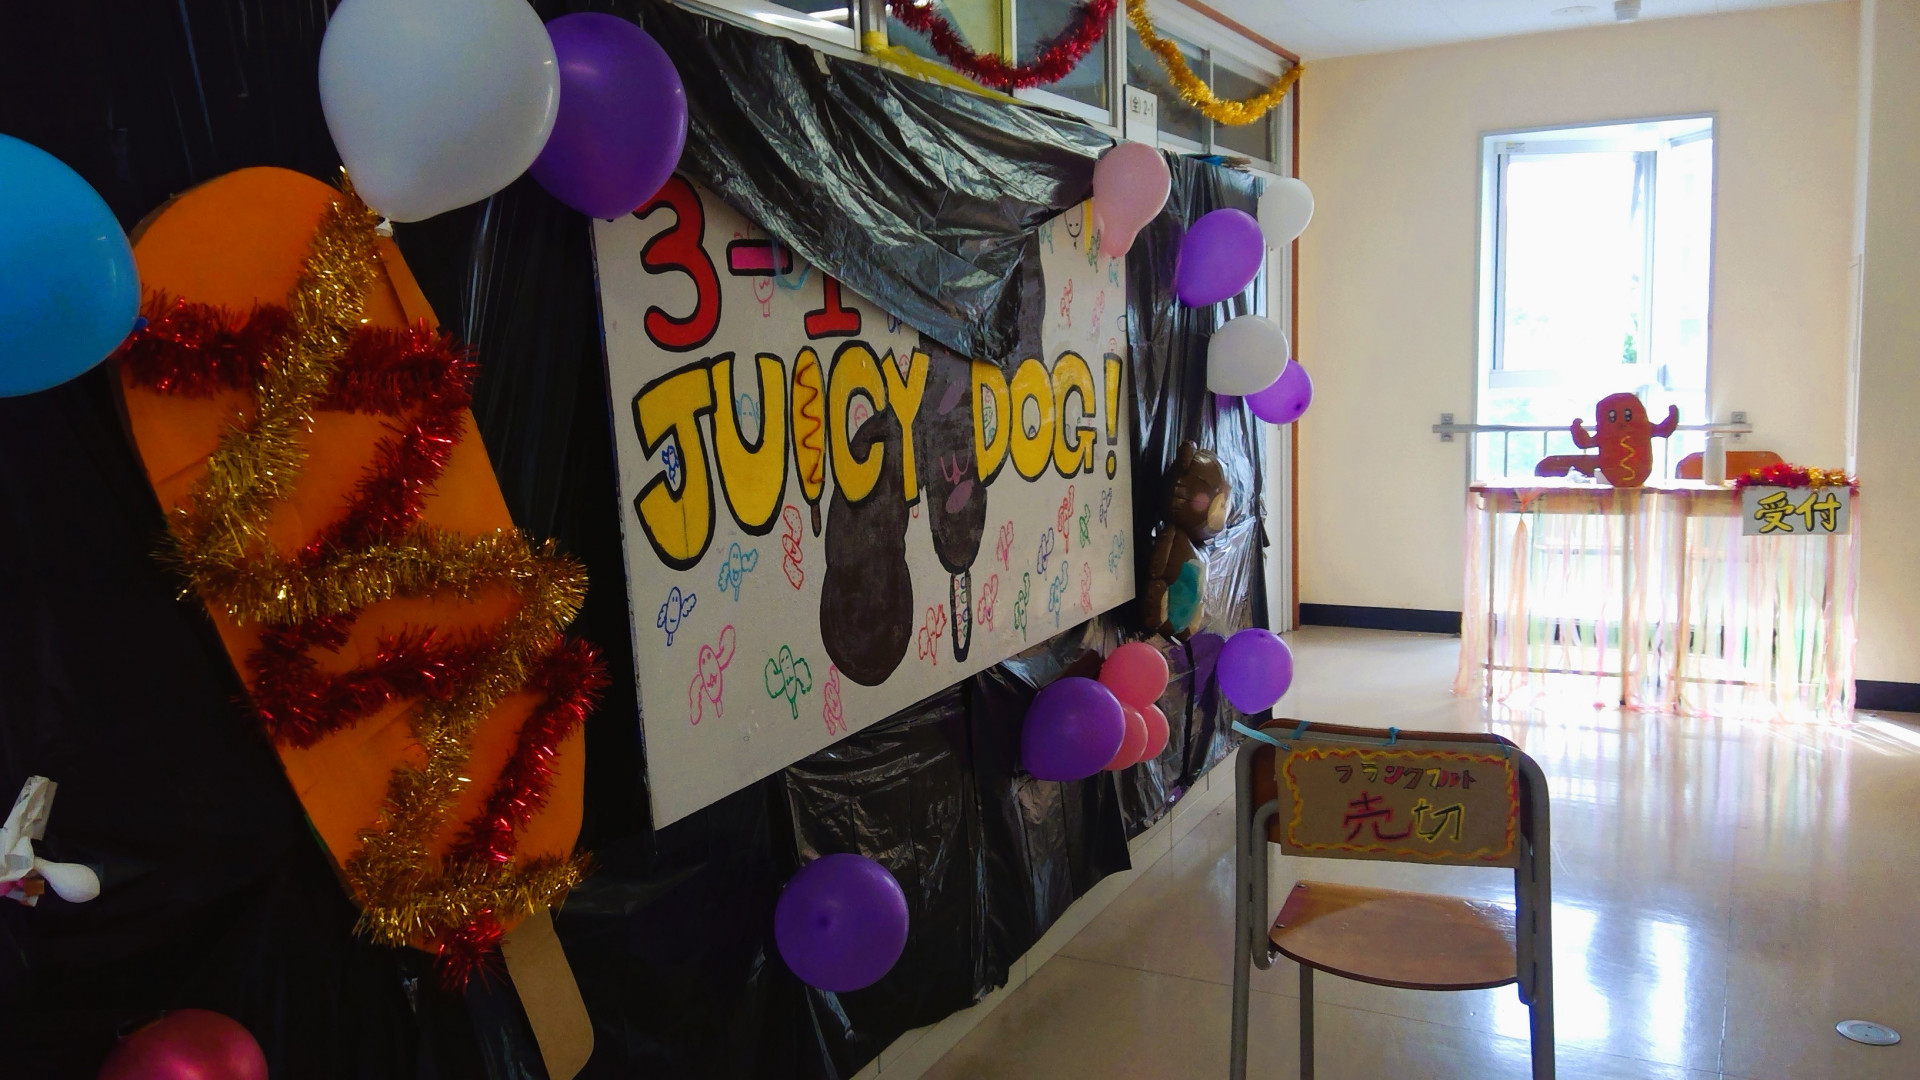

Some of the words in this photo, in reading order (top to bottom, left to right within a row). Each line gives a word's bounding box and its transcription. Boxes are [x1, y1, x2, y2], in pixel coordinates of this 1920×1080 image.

[632, 340, 930, 571] JUICY
[970, 350, 1124, 484] DOG!
[1754, 490, 1842, 533] 受付
[1334, 761, 1477, 790] フランクフルト
[1342, 791, 1464, 843] 売切
